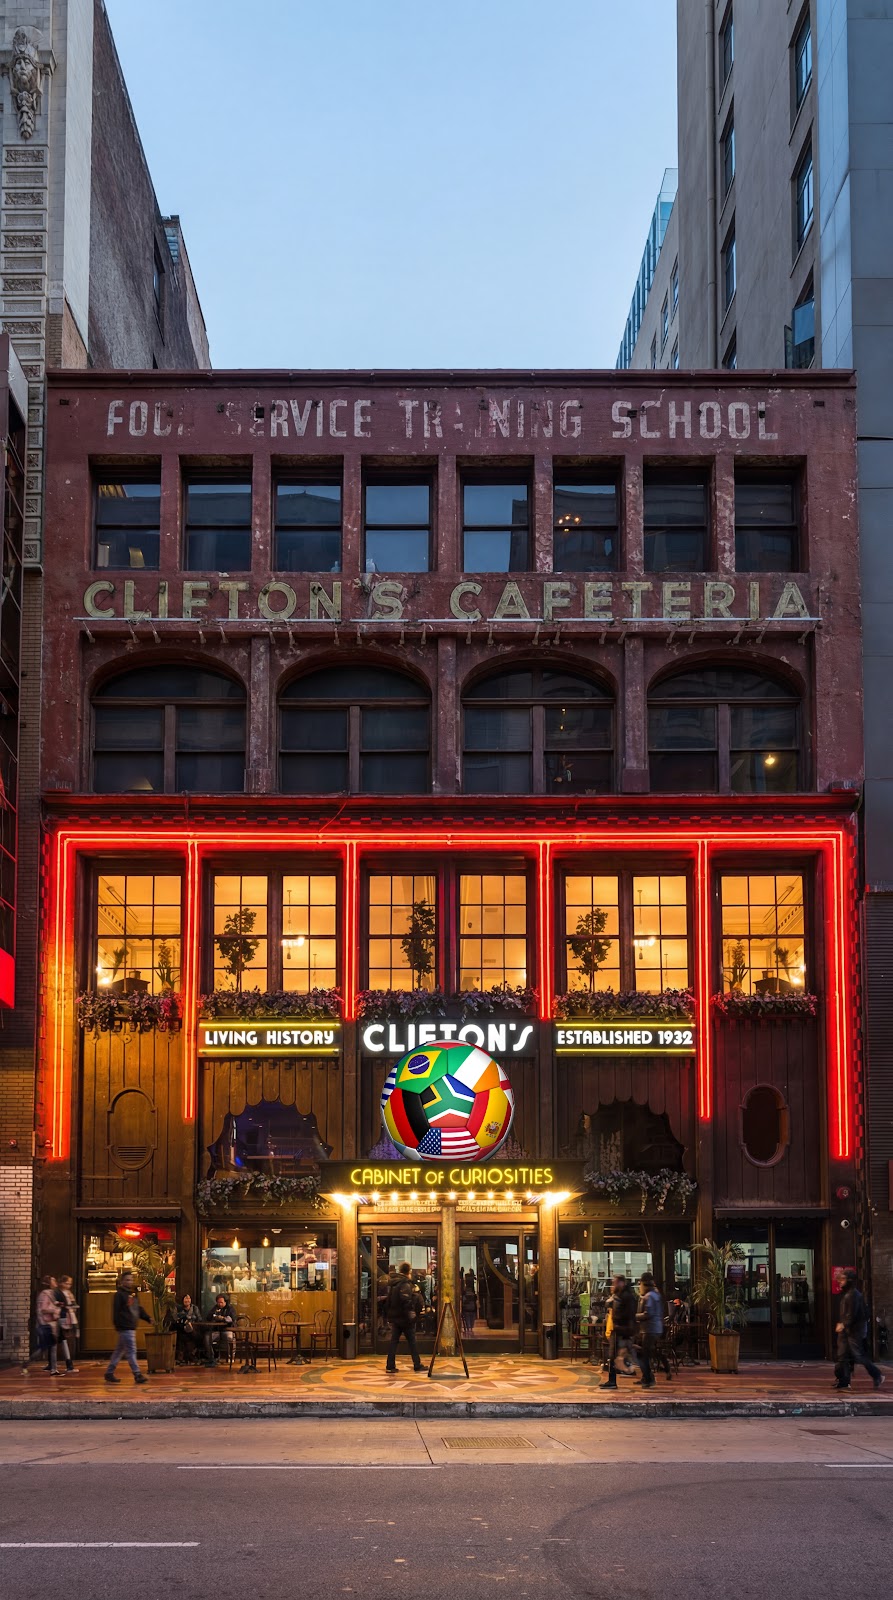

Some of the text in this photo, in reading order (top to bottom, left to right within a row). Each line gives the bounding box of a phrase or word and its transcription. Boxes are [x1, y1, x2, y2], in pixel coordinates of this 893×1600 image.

[107, 400, 190, 437] FOO
[399, 400, 582, 438] TRNING
[611, 400, 779, 440] SCHOOL
[83, 580, 811, 621] CLIFTONS CAFETERIA
[205, 1030, 335, 1045] LIVING HISTORY
[363, 1023, 534, 1052] CLIFTON'S
[557, 1030, 694, 1045] ESTABLISHED 1932
[350, 1167, 422, 1185] CABINET
[449, 1167, 554, 1185] CURIOSITIES
